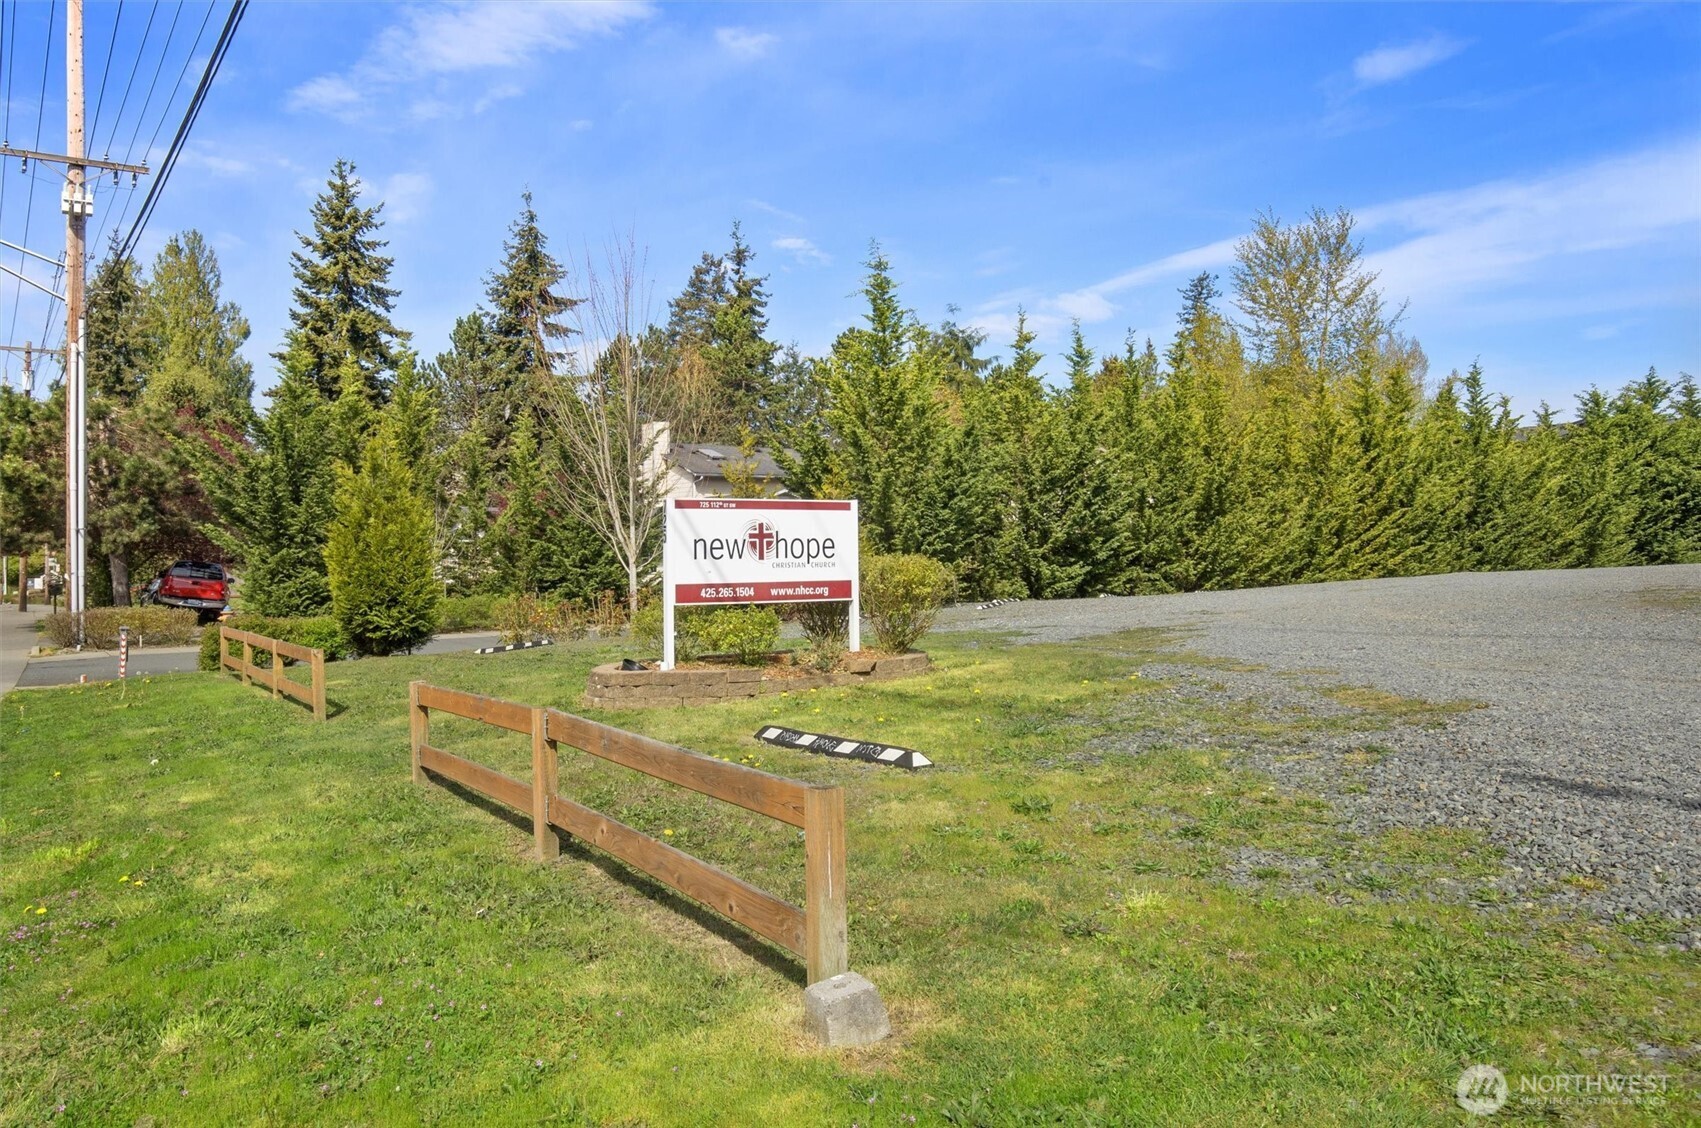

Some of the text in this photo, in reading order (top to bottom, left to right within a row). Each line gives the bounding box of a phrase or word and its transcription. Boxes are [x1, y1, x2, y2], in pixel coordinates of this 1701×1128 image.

[693, 530, 835, 564] new hope
[771, 561, 806, 569] CHRISTIAN
[700, 585, 829, 598] 425.265.1504 www.nhcc.org
